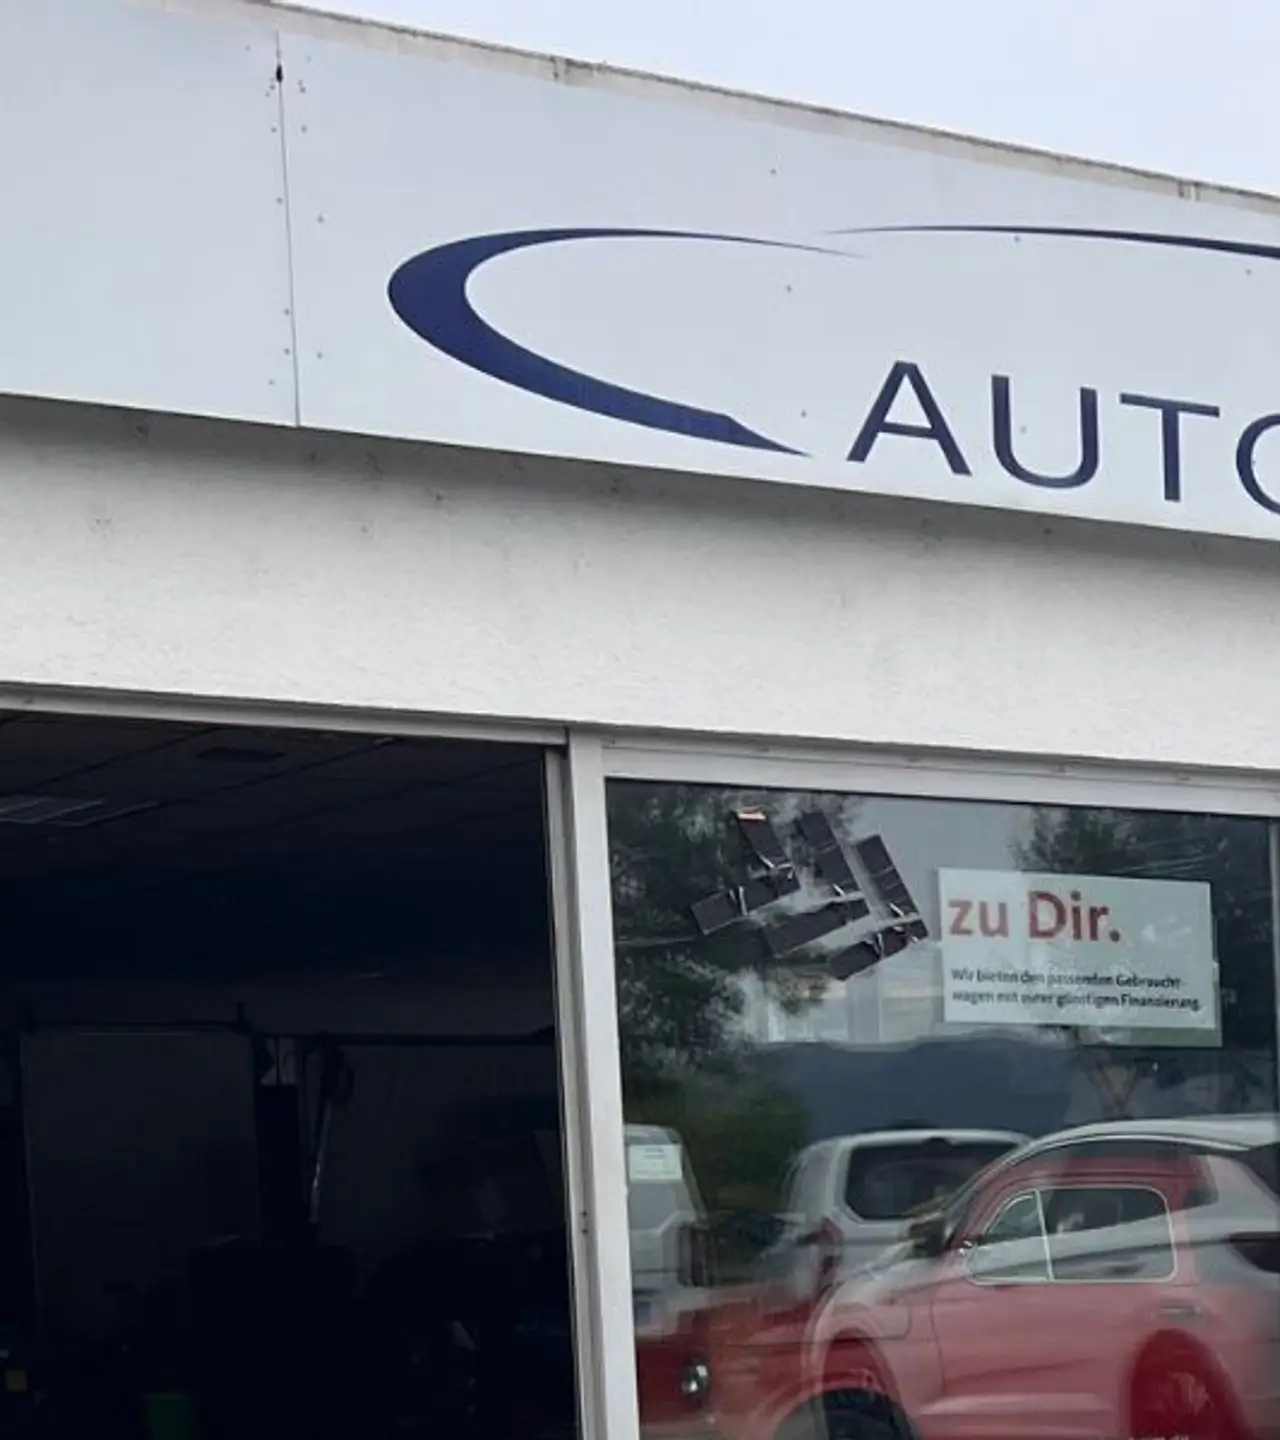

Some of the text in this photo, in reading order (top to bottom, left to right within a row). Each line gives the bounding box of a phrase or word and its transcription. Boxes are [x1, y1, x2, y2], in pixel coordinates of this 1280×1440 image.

[948, 889, 1121, 943] zu Dir.
[976, 969, 1019, 984] bieten
[1020, 970, 1045, 984] den
[1047, 971, 1114, 988] passenden
